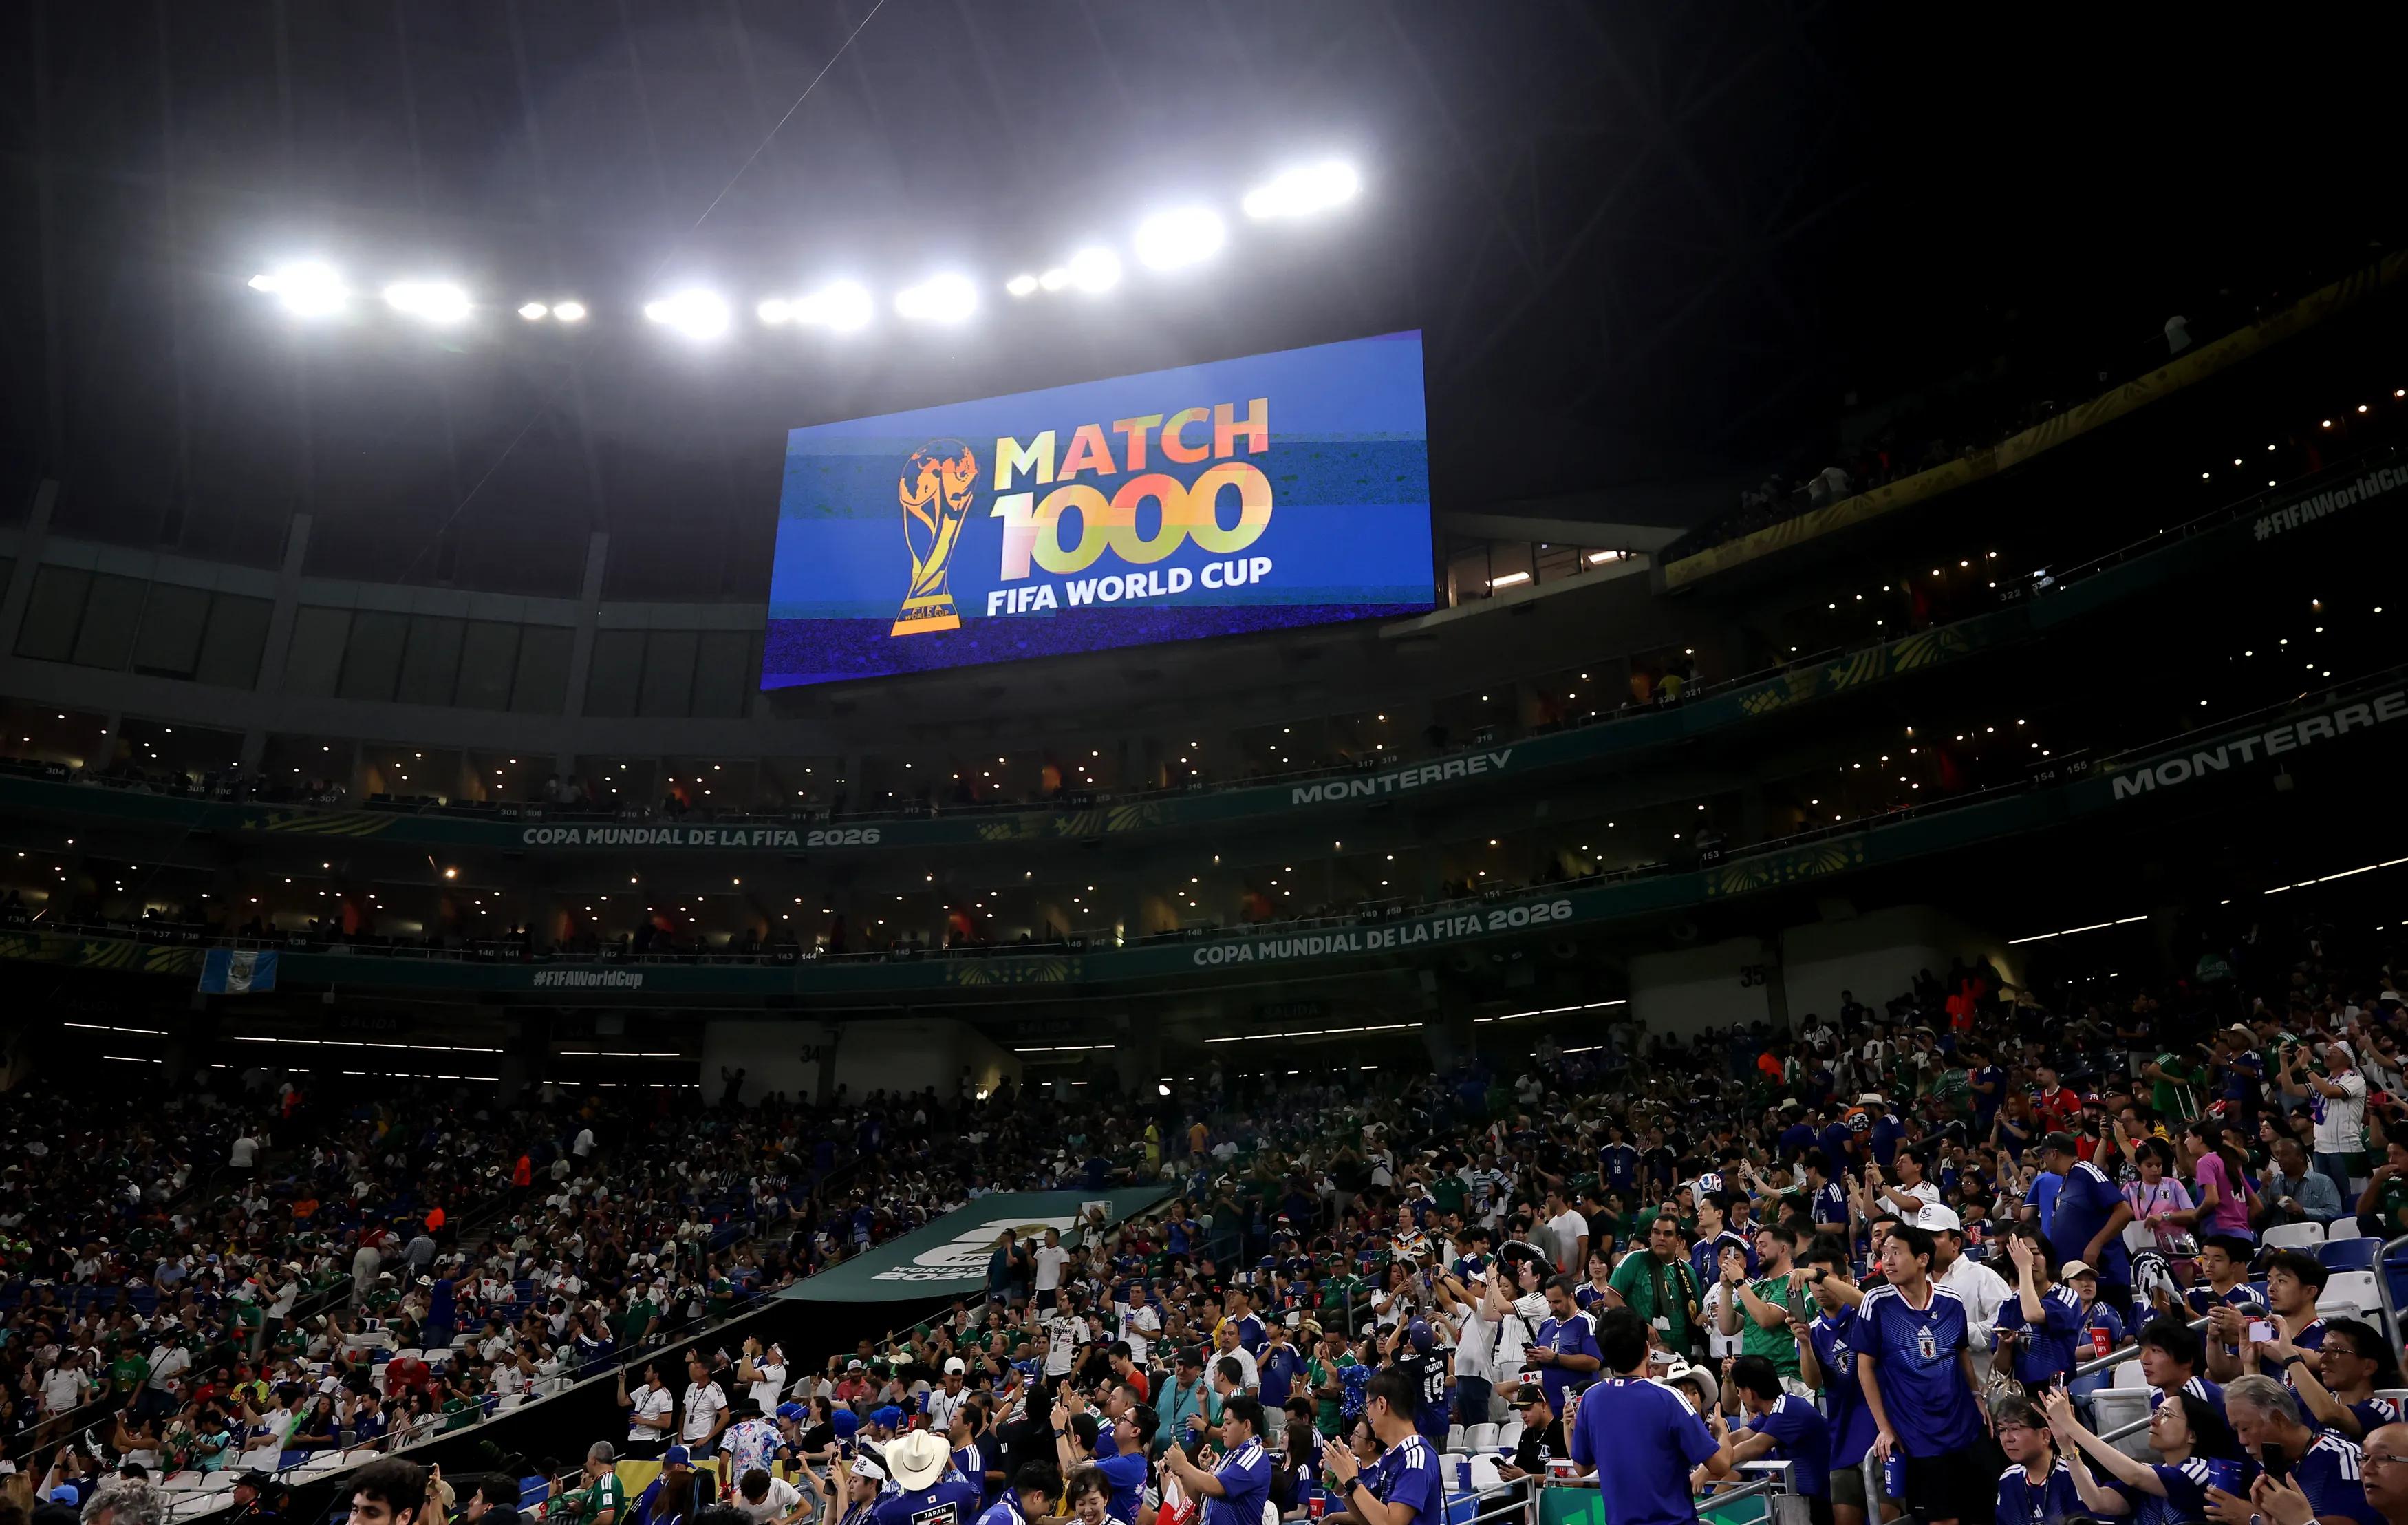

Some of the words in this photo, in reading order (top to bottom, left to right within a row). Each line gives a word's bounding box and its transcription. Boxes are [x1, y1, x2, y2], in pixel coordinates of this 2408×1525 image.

[994, 398, 1269, 491] MATCH
[989, 462, 1273, 581] 1000
[987, 584, 1058, 617] FIFA
[1066, 567, 1193, 606] WORLD
[1200, 557, 1273, 589] CUP
[1999, 589, 2021, 601] 322
[905, 612, 932, 621] WORLD
[912, 605, 943, 615] FIFA
[1685, 687, 1701, 698] 321
[1291, 749, 1512, 804] MONTERREY
[2034, 770, 2055, 782] 154
[2067, 760, 2087, 774] 155
[523, 829, 581, 845] COPA
[585, 829, 684, 845] MUNDIAL
[689, 830, 716, 845] DE
[720, 830, 746, 845] LA
[752, 831, 799, 846] FIFA
[807, 829, 881, 846] 2026
[1702, 850, 1719, 860] 153
[1194, 943, 1254, 965] COPA
[1258, 932, 1362, 960] MUNDIAL
[1366, 930, 1396, 950] DE
[1401, 924, 1428, 947] LA
[1433, 914, 1483, 940] FIFA
[1487, 899, 1573, 930] 2026
[533, 970, 643, 990] #FIFAWorldCup
[1740, 963, 1765, 988] 35
[338, 1014, 397, 1031] SALIDA
[800, 1045, 820, 1063] 34
[1614, 1165, 1621, 1174] 18
[871, 1272, 987, 1281] 2026
[1424, 1360, 1443, 1374] OGAWA
[1424, 1372, 1445, 1403] 19
[924, 1507, 947, 1519] JAPAN
